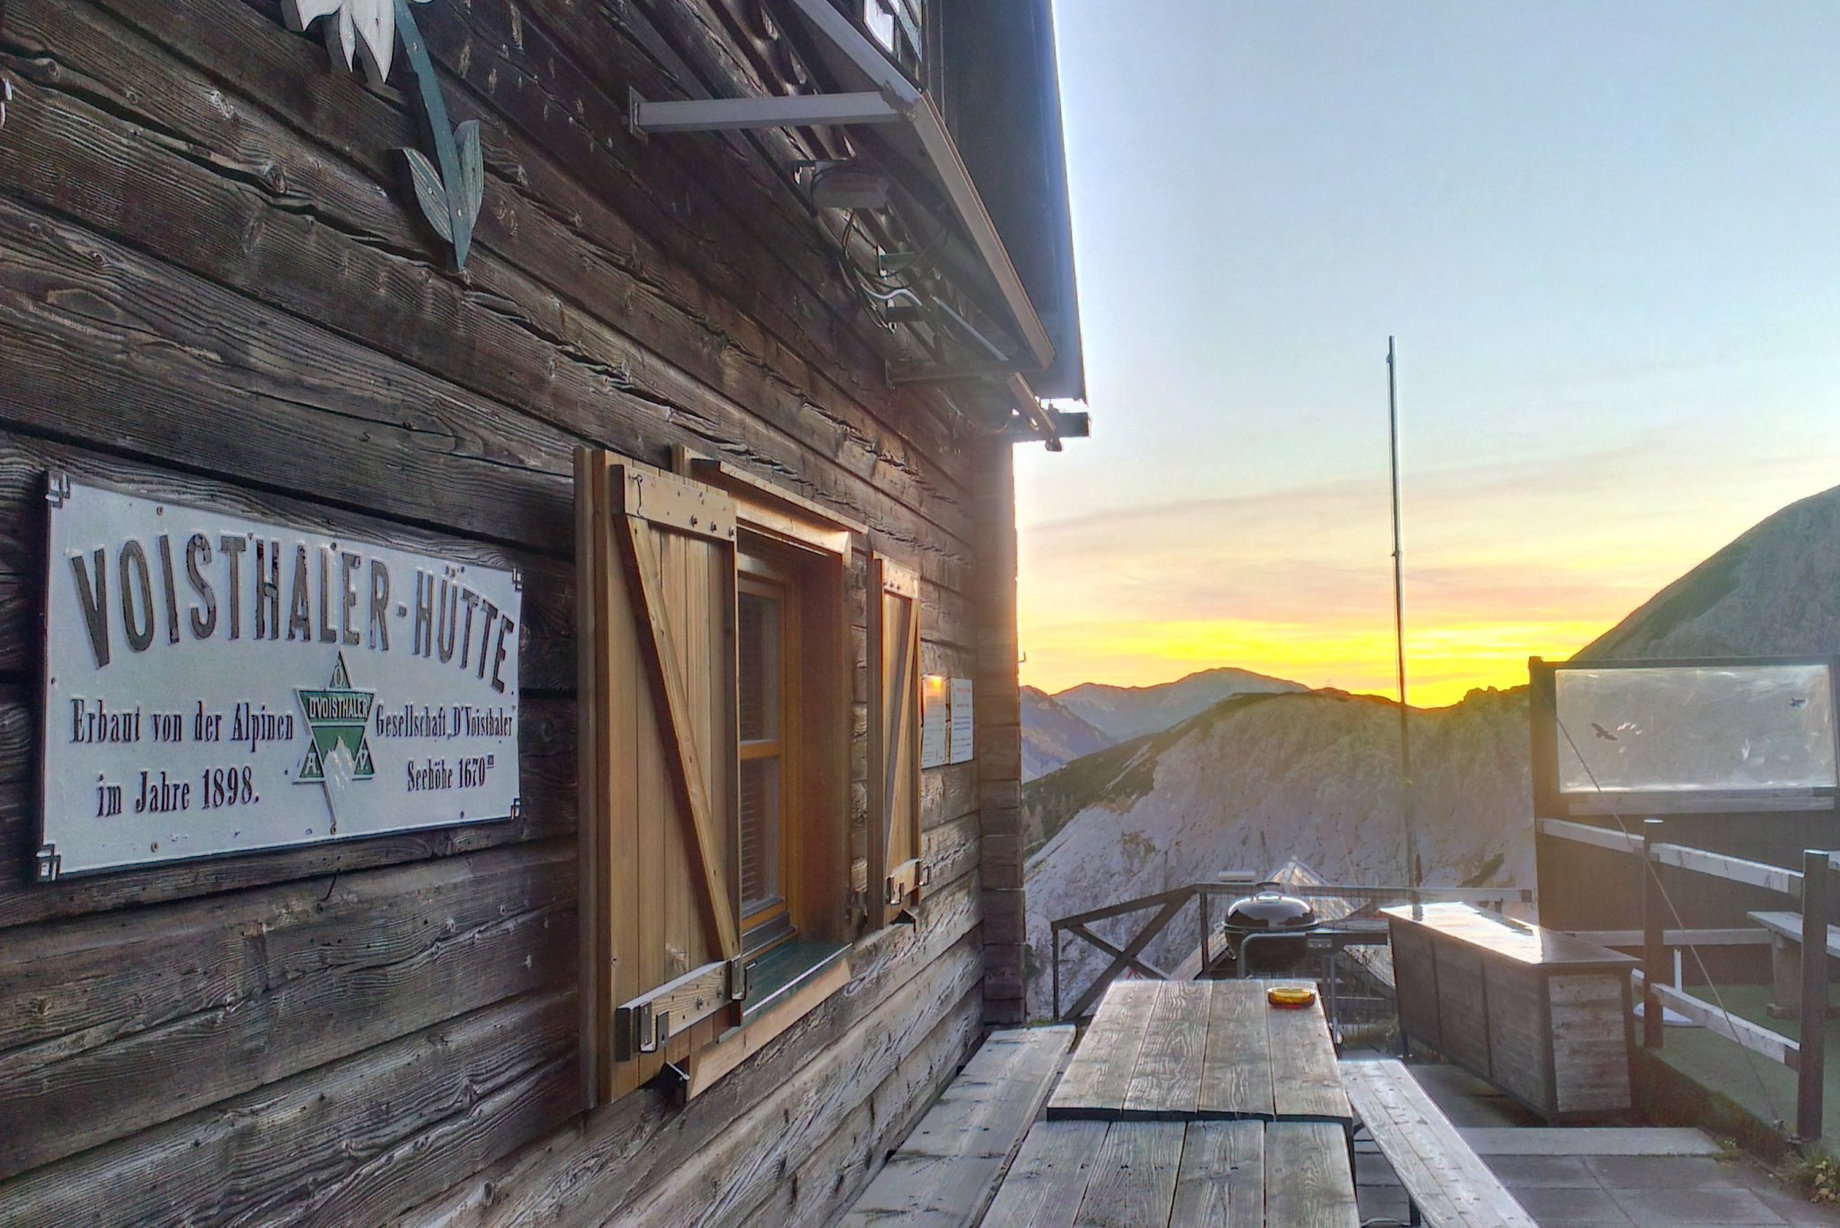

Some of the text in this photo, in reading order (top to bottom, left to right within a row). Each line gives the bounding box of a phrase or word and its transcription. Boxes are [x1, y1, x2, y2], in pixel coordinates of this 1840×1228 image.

[70, 532, 515, 694] VOISTHALER-HÜTTE
[70, 698, 141, 743] Erbaut
[153, 712, 183, 742] von
[194, 700, 222, 742] der
[231, 702, 295, 753] Alpinen
[376, 703, 446, 738] Gesellschaft
[96, 765, 260, 817] im Jahre 1898.
[407, 758, 453, 792] Seehöhe
